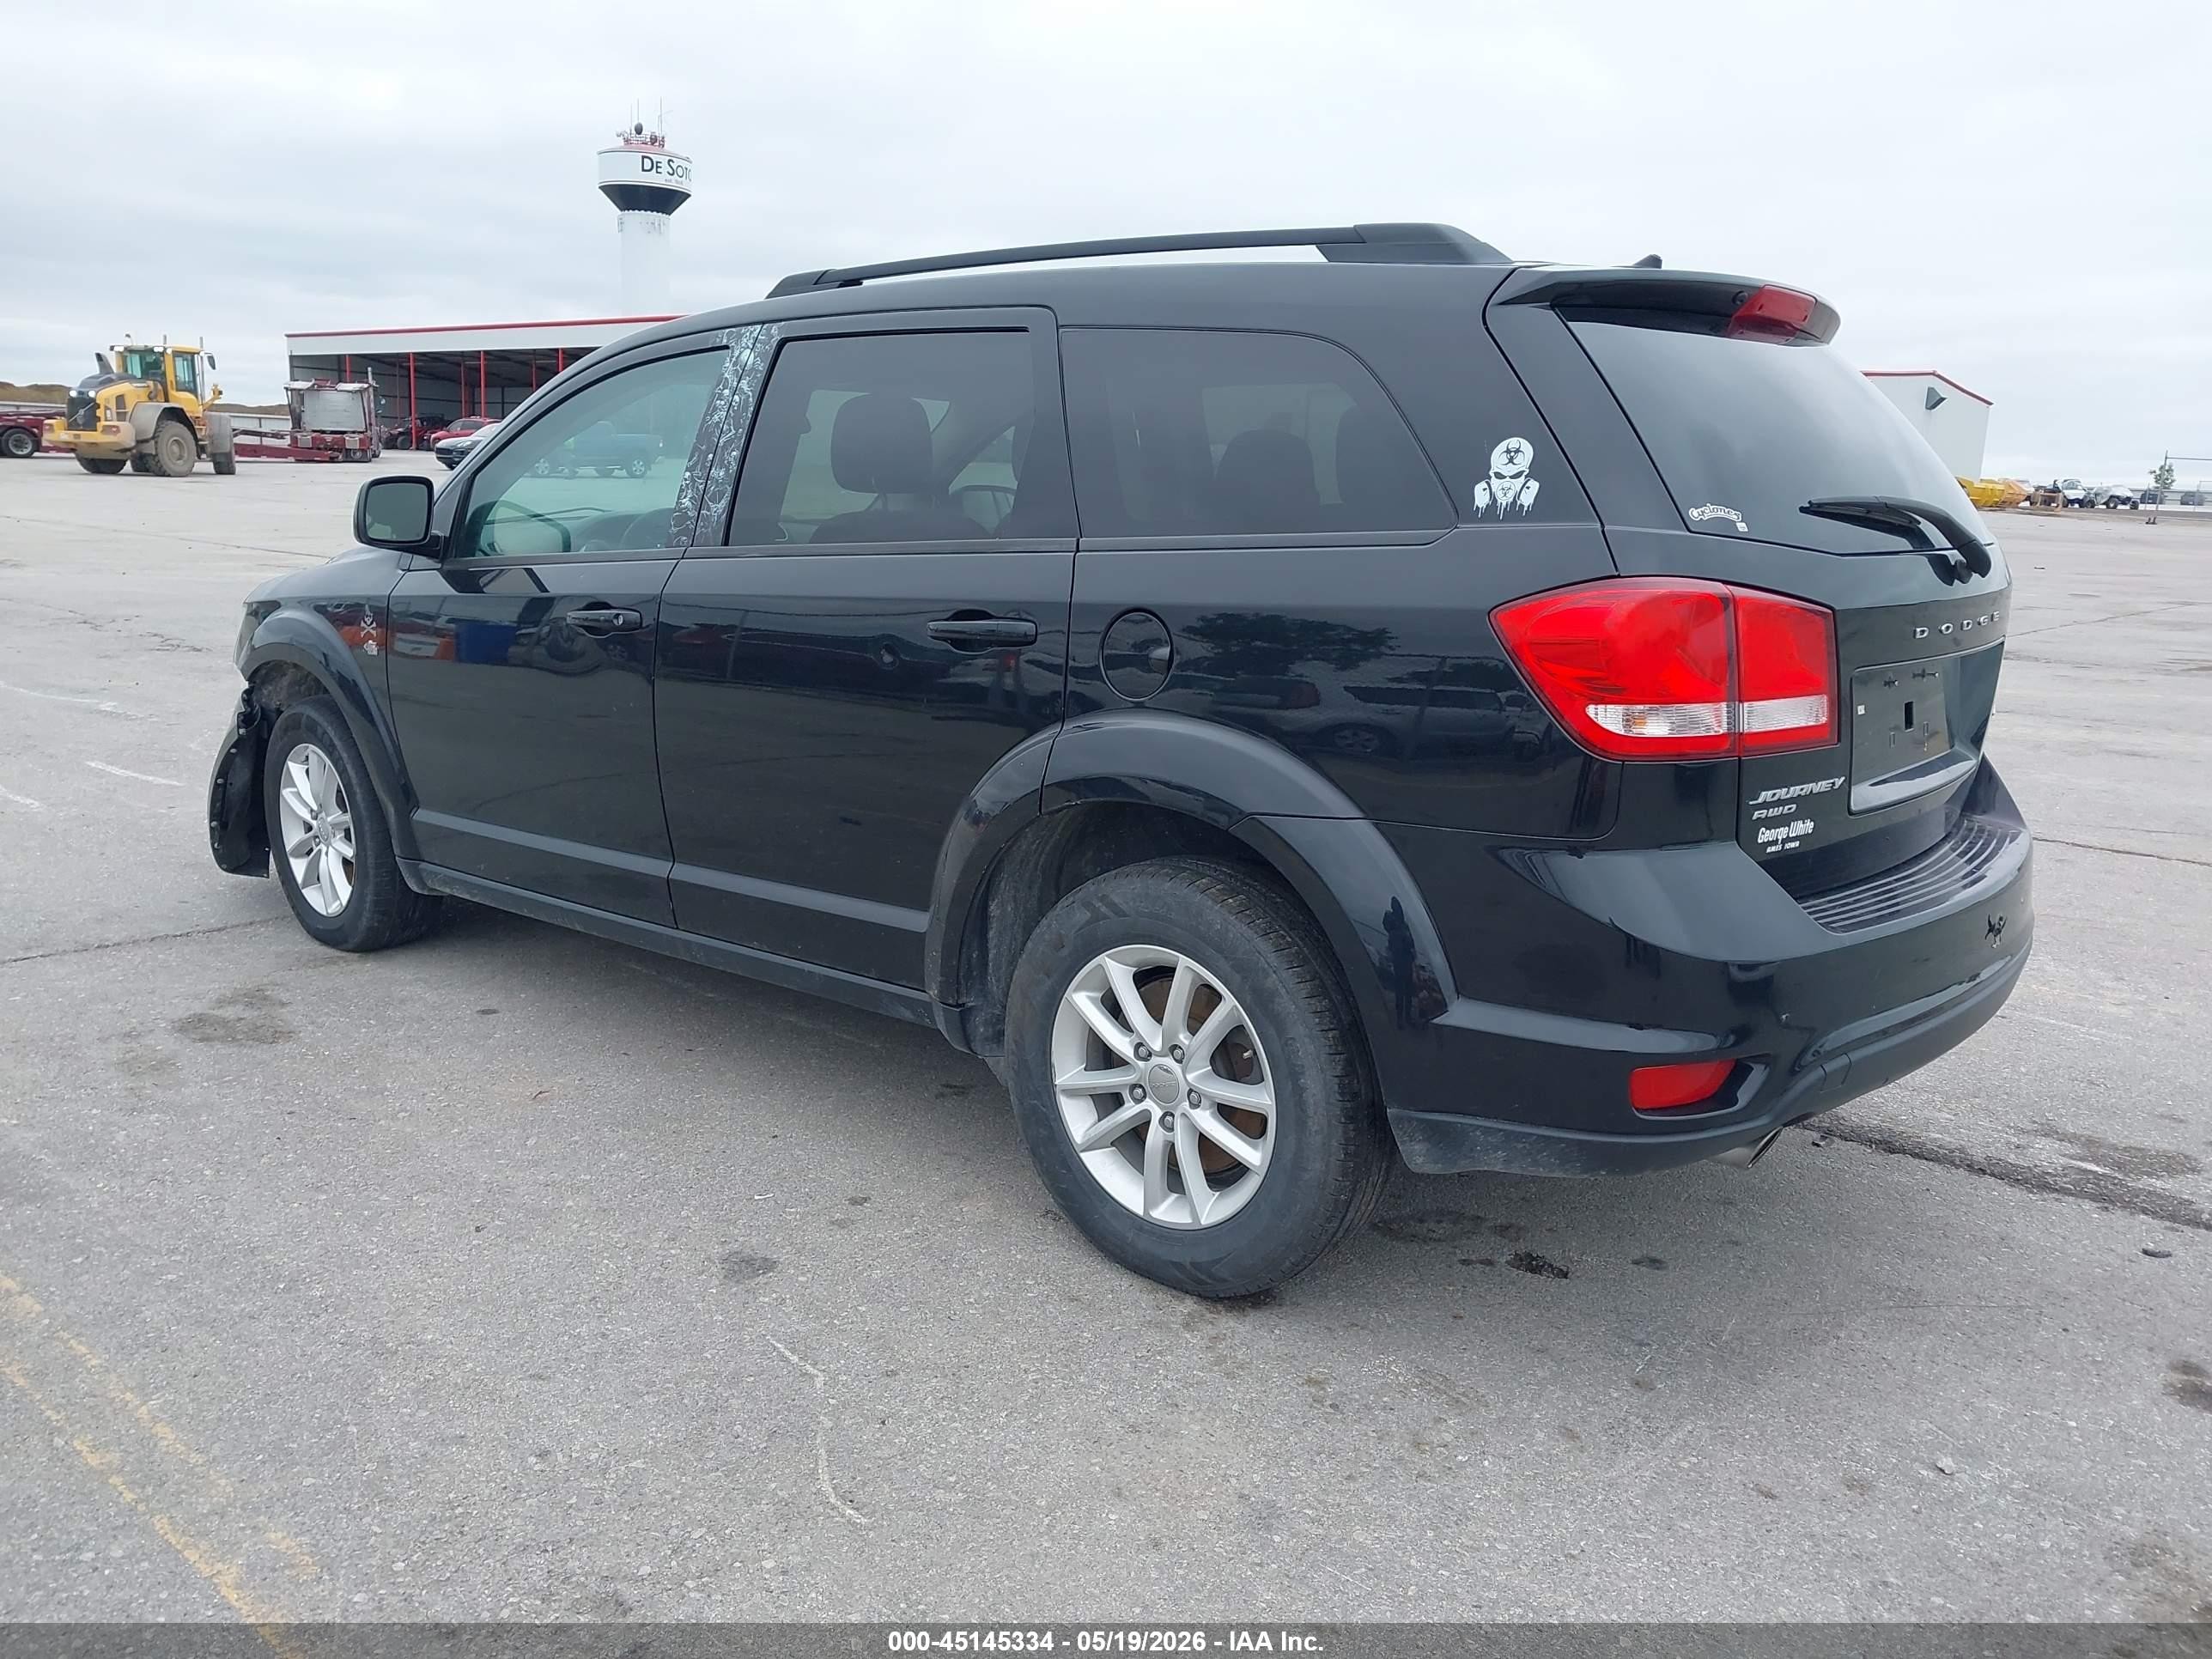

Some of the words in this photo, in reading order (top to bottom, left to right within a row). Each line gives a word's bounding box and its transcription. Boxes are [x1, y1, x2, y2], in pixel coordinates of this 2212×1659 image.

[1688, 503, 1742, 522] Cyclones
[1914, 611, 2000, 639] DODGE
[1748, 776, 1845, 805] JOURNEY
[1752, 804, 1796, 820] AWD
[1757, 827, 1789, 845] George
[1789, 818, 1814, 837] White
[1765, 844, 1783, 854] AMES
